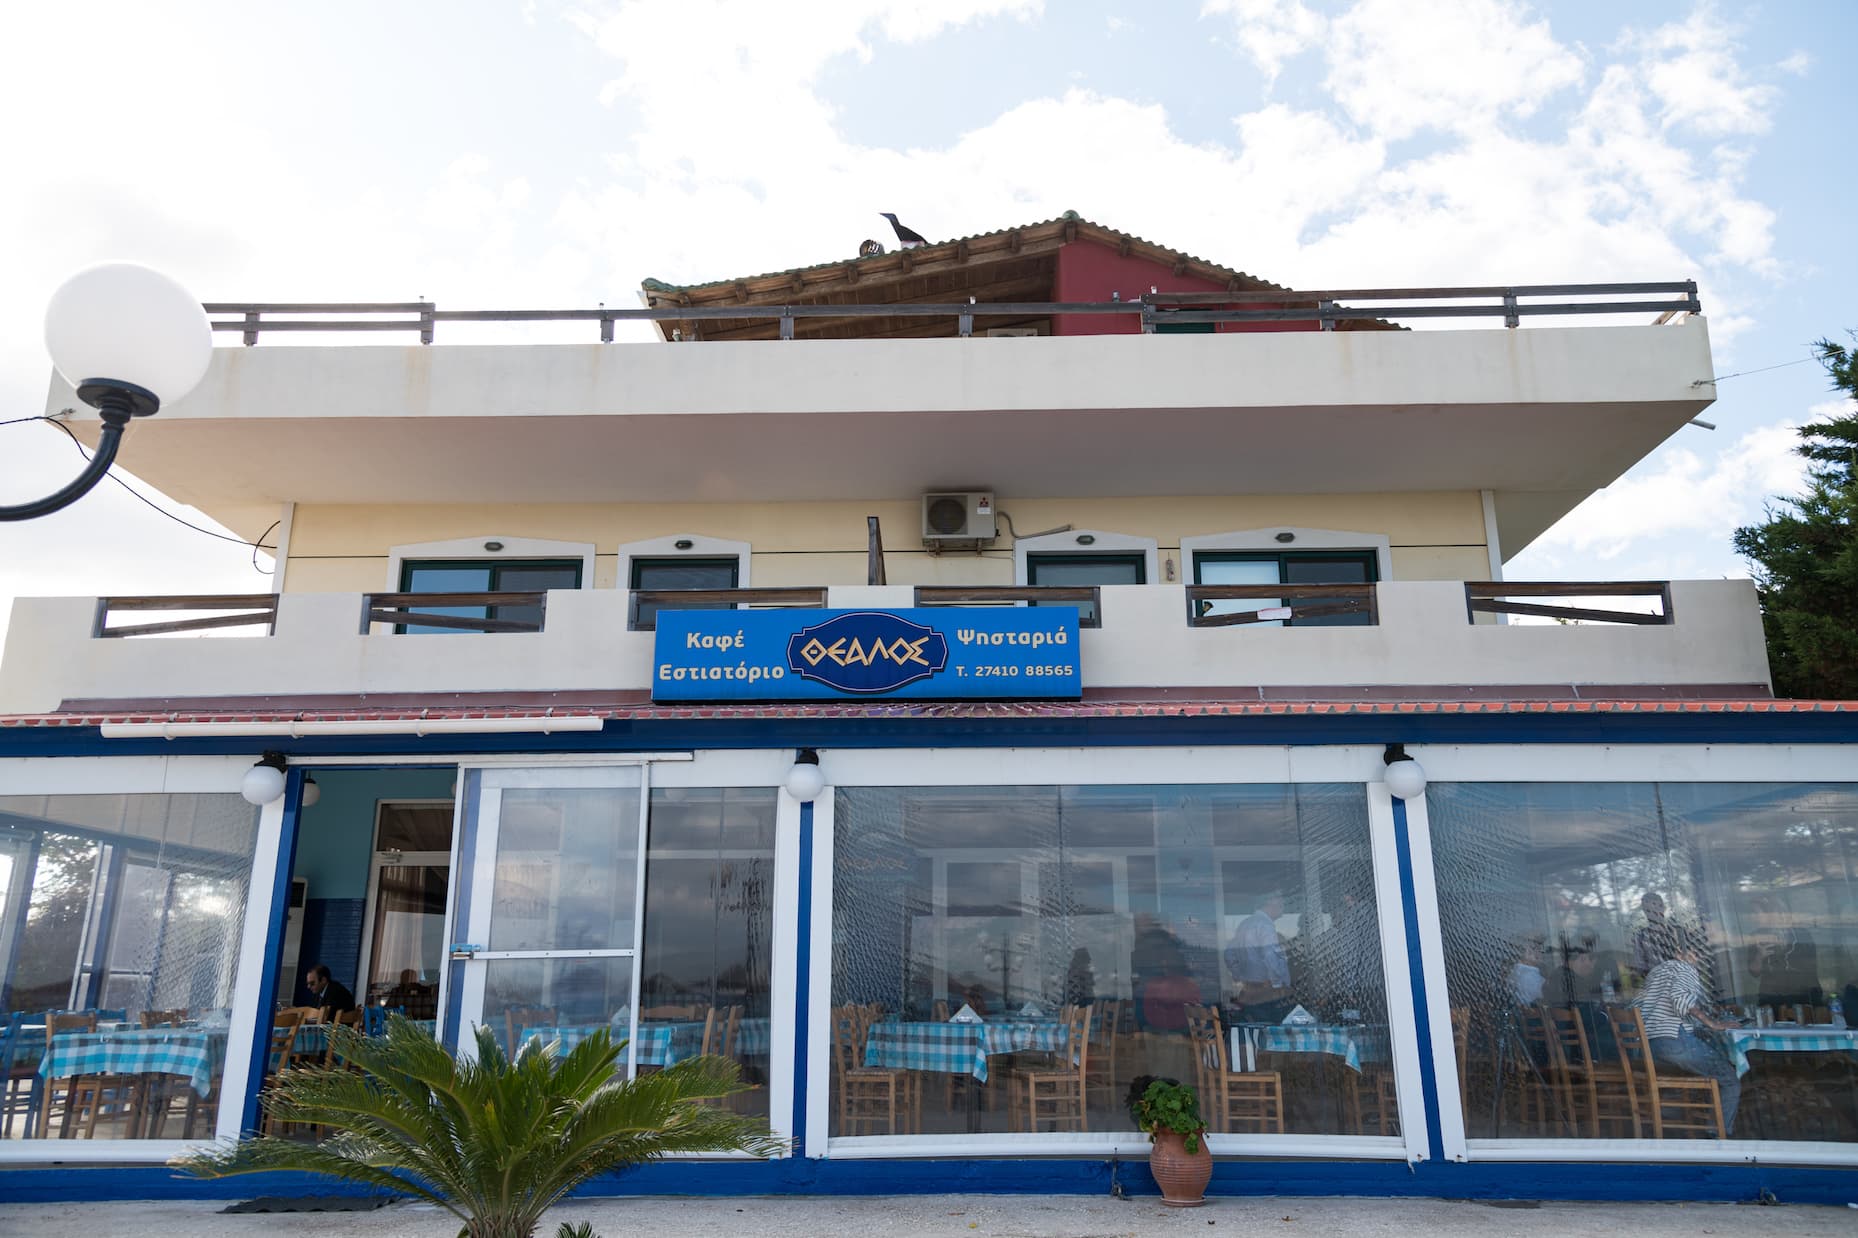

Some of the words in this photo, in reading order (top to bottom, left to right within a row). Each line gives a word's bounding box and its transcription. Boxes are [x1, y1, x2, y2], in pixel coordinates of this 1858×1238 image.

[686, 629, 745, 652] Καφέ
[957, 626, 1068, 649] Ψησταριά
[800, 637, 930, 667] ΘΕΑΛΟΣ
[659, 660, 785, 684] Εστιατόριο
[975, 665, 1019, 677] 27410
[1025, 665, 1073, 676] 88565
